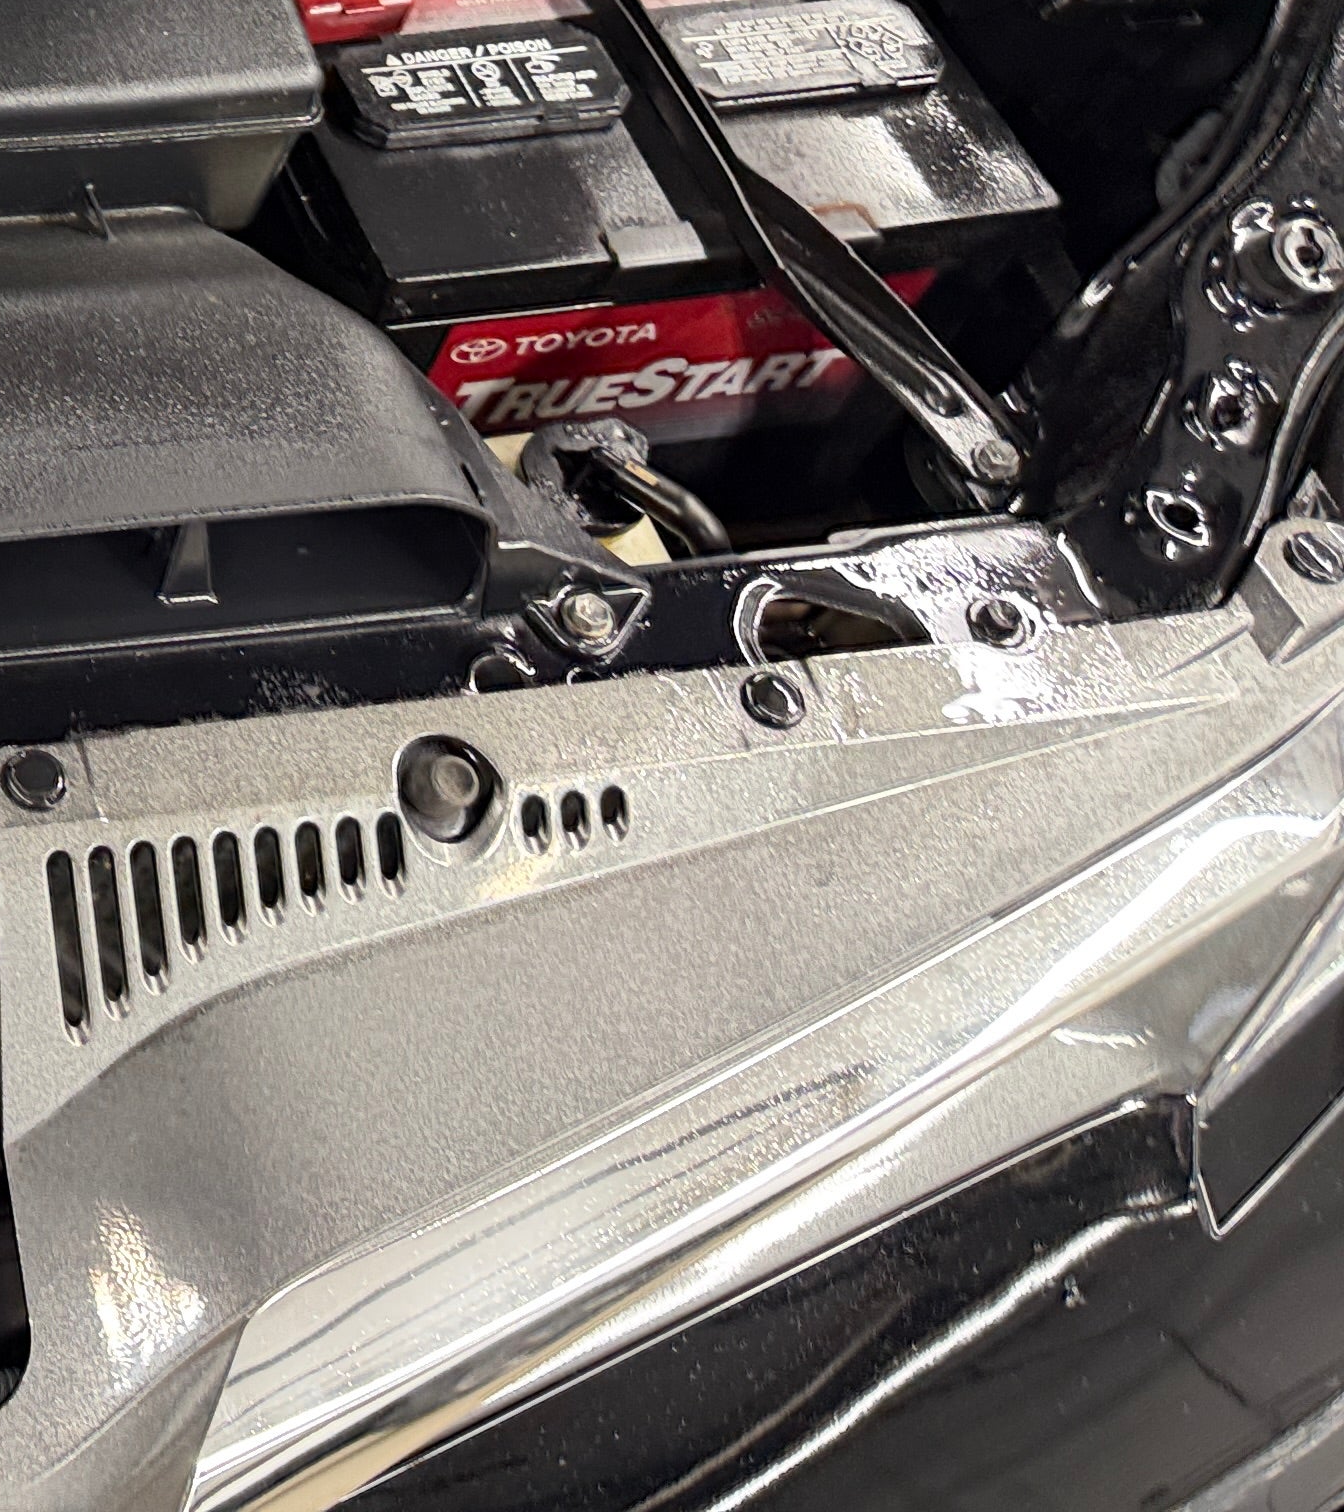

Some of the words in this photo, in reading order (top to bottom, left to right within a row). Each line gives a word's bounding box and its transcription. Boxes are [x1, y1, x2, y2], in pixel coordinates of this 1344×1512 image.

[401, 47, 473, 65] DANGER
[489, 38, 553, 55] POISON
[515, 322, 658, 356] TOYOTA
